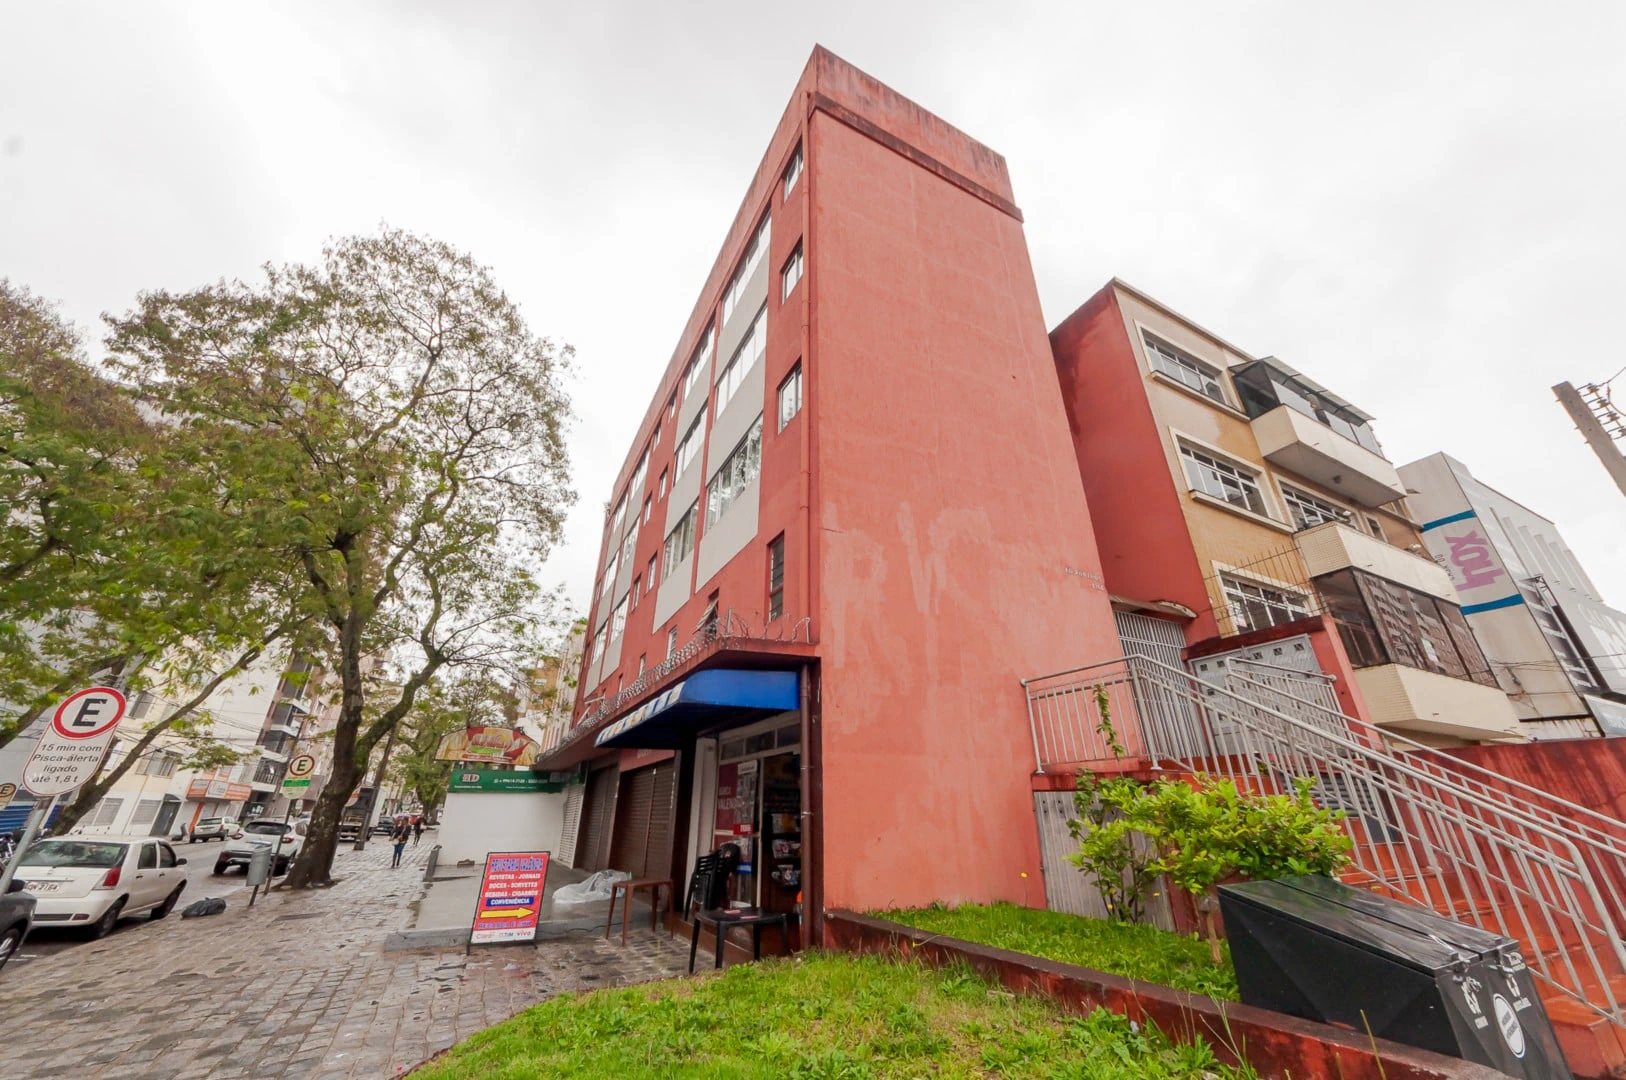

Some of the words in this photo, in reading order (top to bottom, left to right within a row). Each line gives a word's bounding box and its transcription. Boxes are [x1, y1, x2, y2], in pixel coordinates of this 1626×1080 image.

[72, 698, 108, 727] E
[32, 754, 98, 762] Pisca-alerta
[43, 765, 78, 774] ligado
[296, 759, 308, 772] E
[55, 775, 72, 784] 1,8
[73, 775, 79, 783] t
[490, 897, 530, 905] CONVENIÊNCIA
